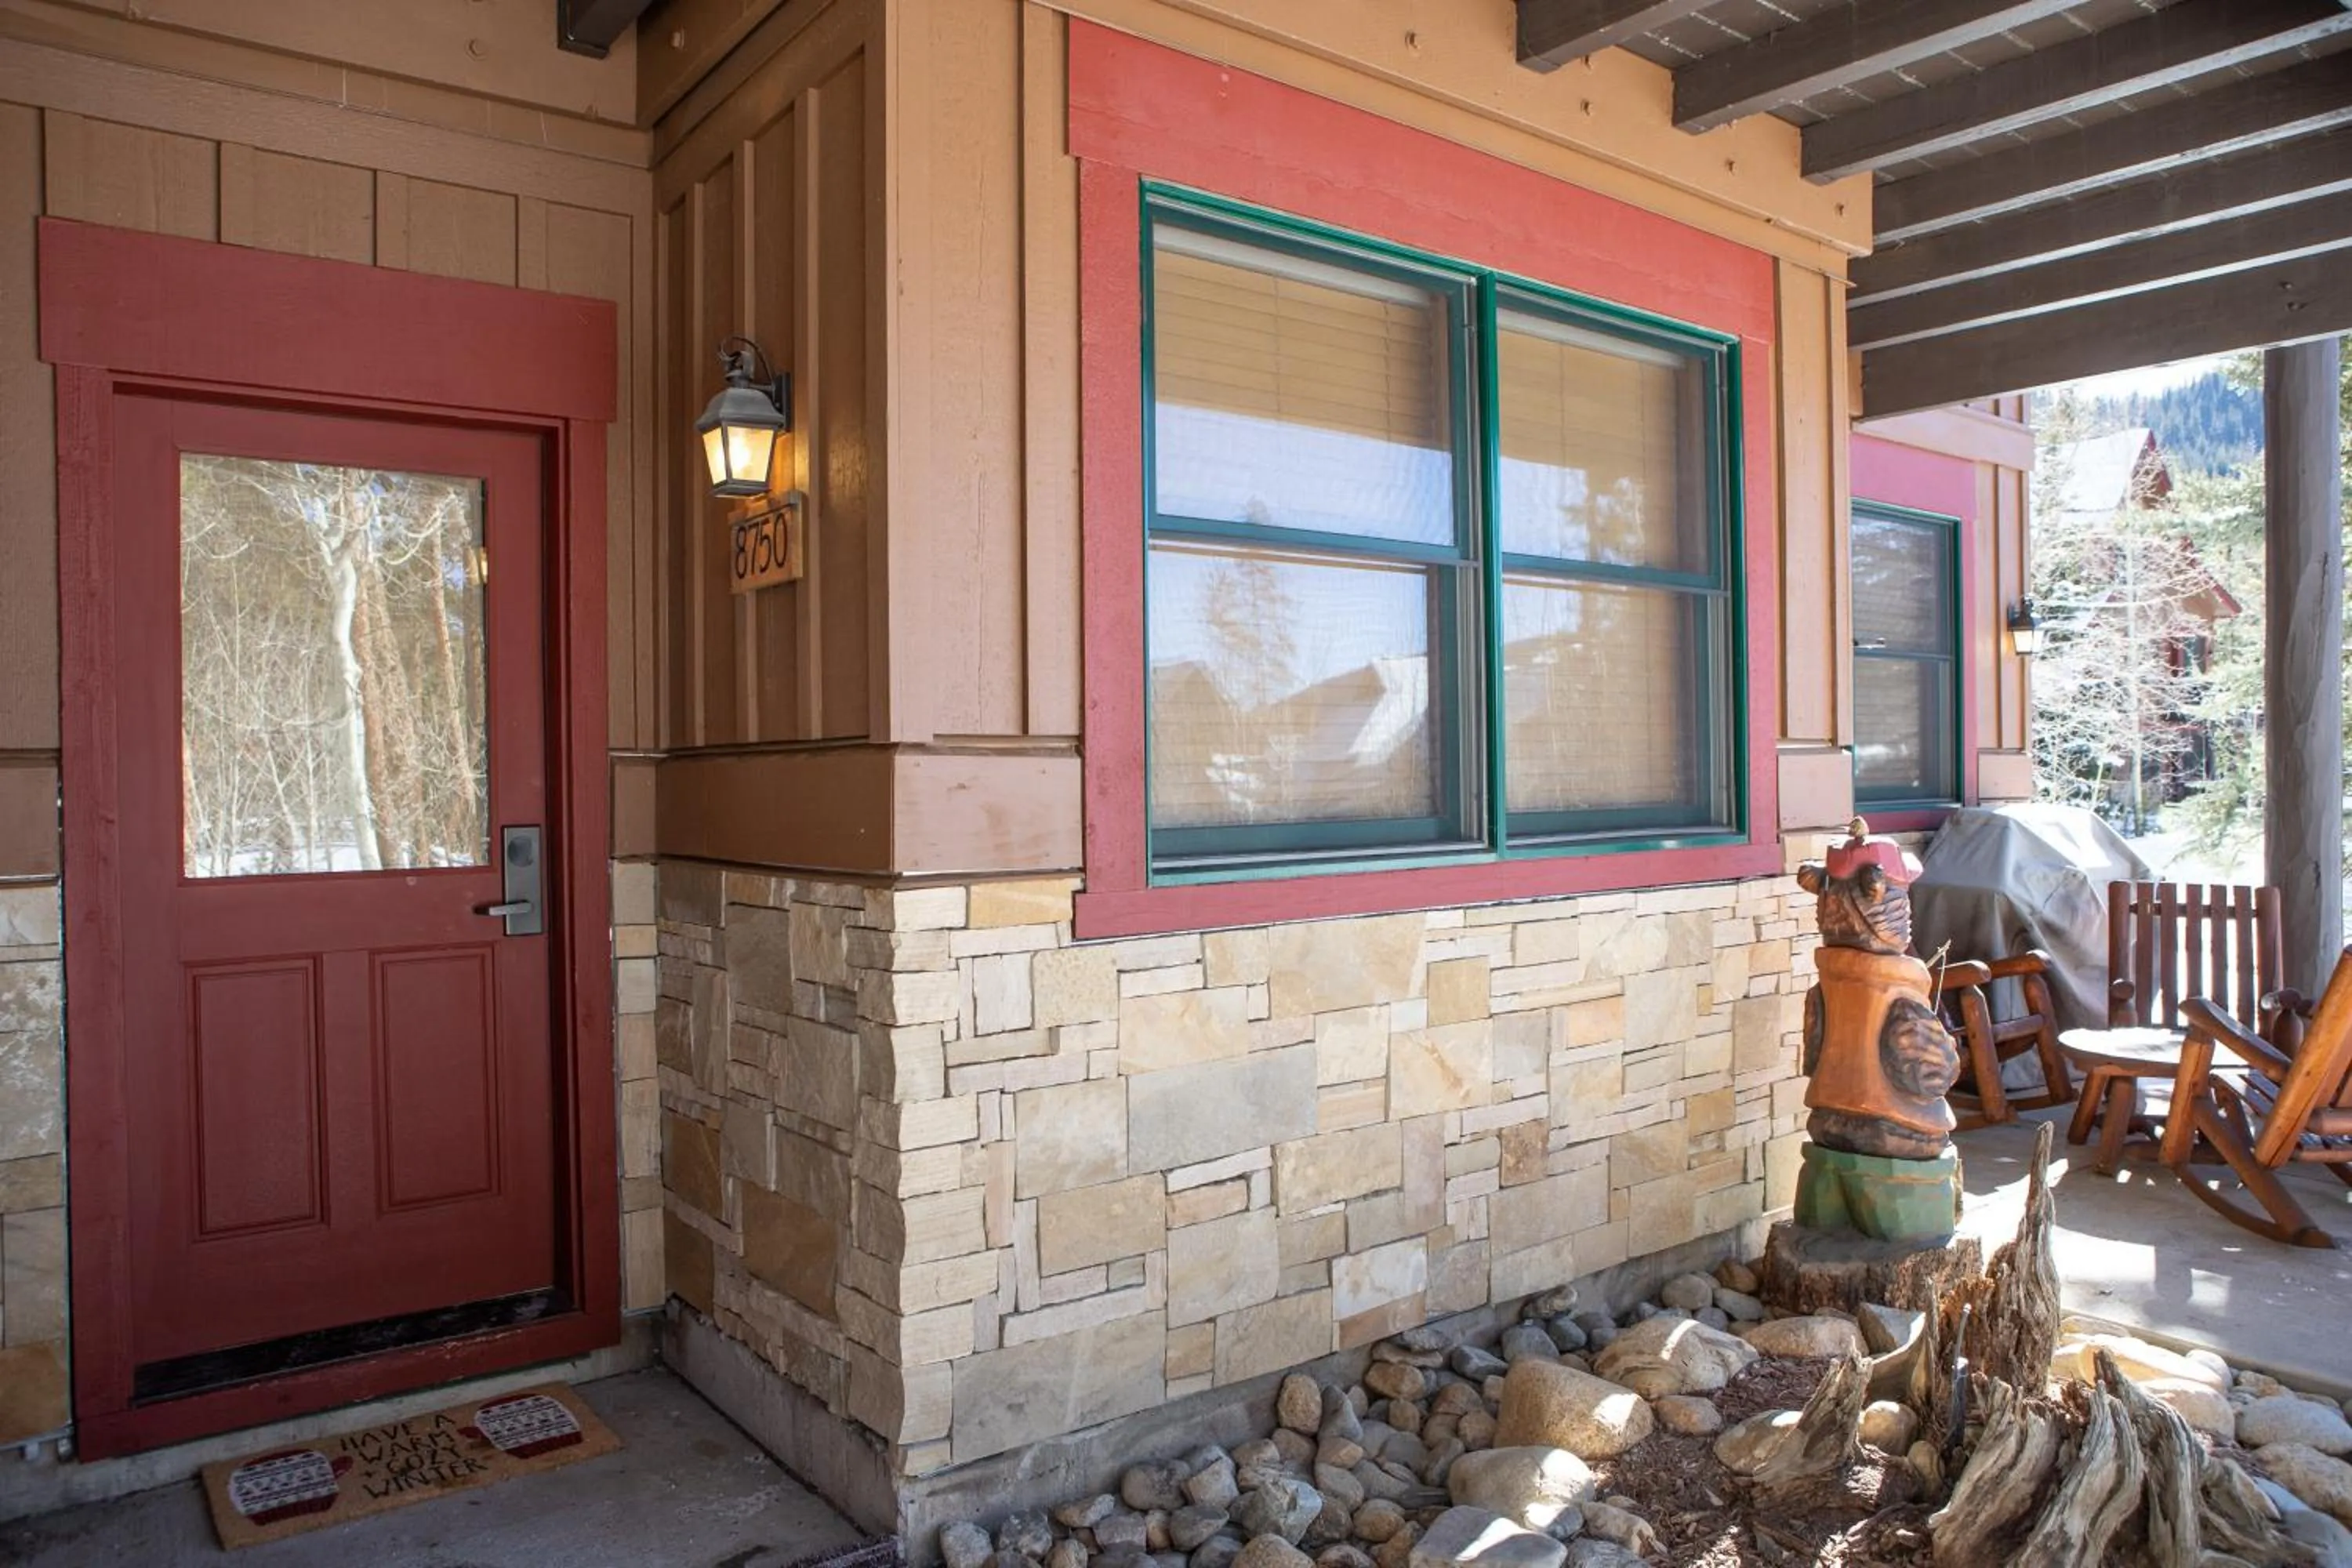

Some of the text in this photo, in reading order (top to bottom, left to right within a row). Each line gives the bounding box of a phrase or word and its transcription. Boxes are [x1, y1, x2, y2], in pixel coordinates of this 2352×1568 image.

[735, 513, 787, 579] 8750
[339, 1414, 456, 1450] HAVE A
[358, 1430, 456, 1464] WARM
[362, 1457, 488, 1498] WINTER
[387, 1446, 461, 1474] COZY
